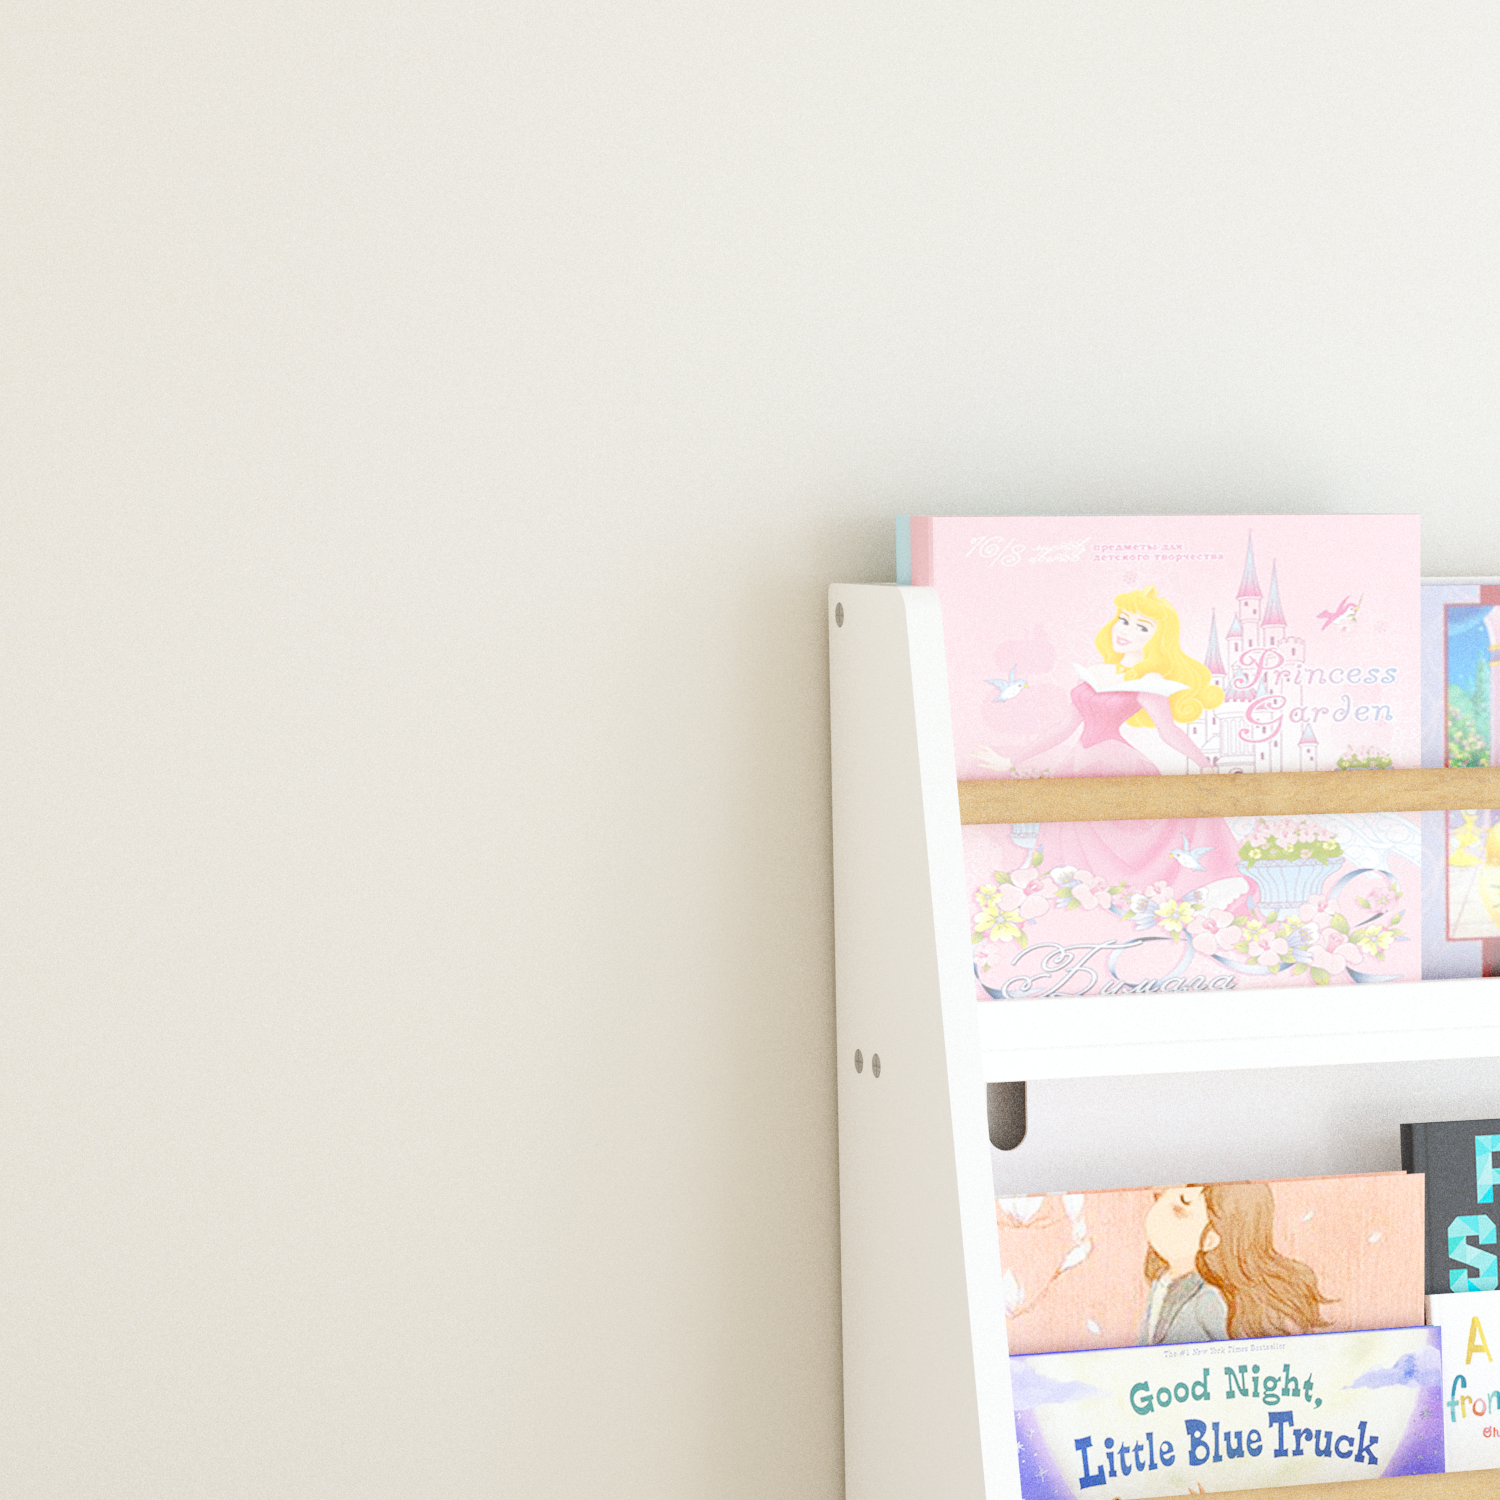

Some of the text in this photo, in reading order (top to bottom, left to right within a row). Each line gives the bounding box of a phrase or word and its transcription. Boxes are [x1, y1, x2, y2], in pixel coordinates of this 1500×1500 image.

[1232, 647, 1399, 690] Princess
[1238, 693, 1395, 744] Garden
[1163, 1350, 1178, 1359] The
[1192, 1348, 1208, 1356] New
[1210, 1346, 1226, 1355] York
[1228, 1345, 1249, 1354] Times
[1250, 1343, 1287, 1352] Bestseller
[1465, 1315, 1493, 1365] A
[1129, 1363, 1323, 1416] Good Night,
[1074, 1410, 1379, 1490] Little Blue Truck
[1482, 1423, 1500, 1439] on
